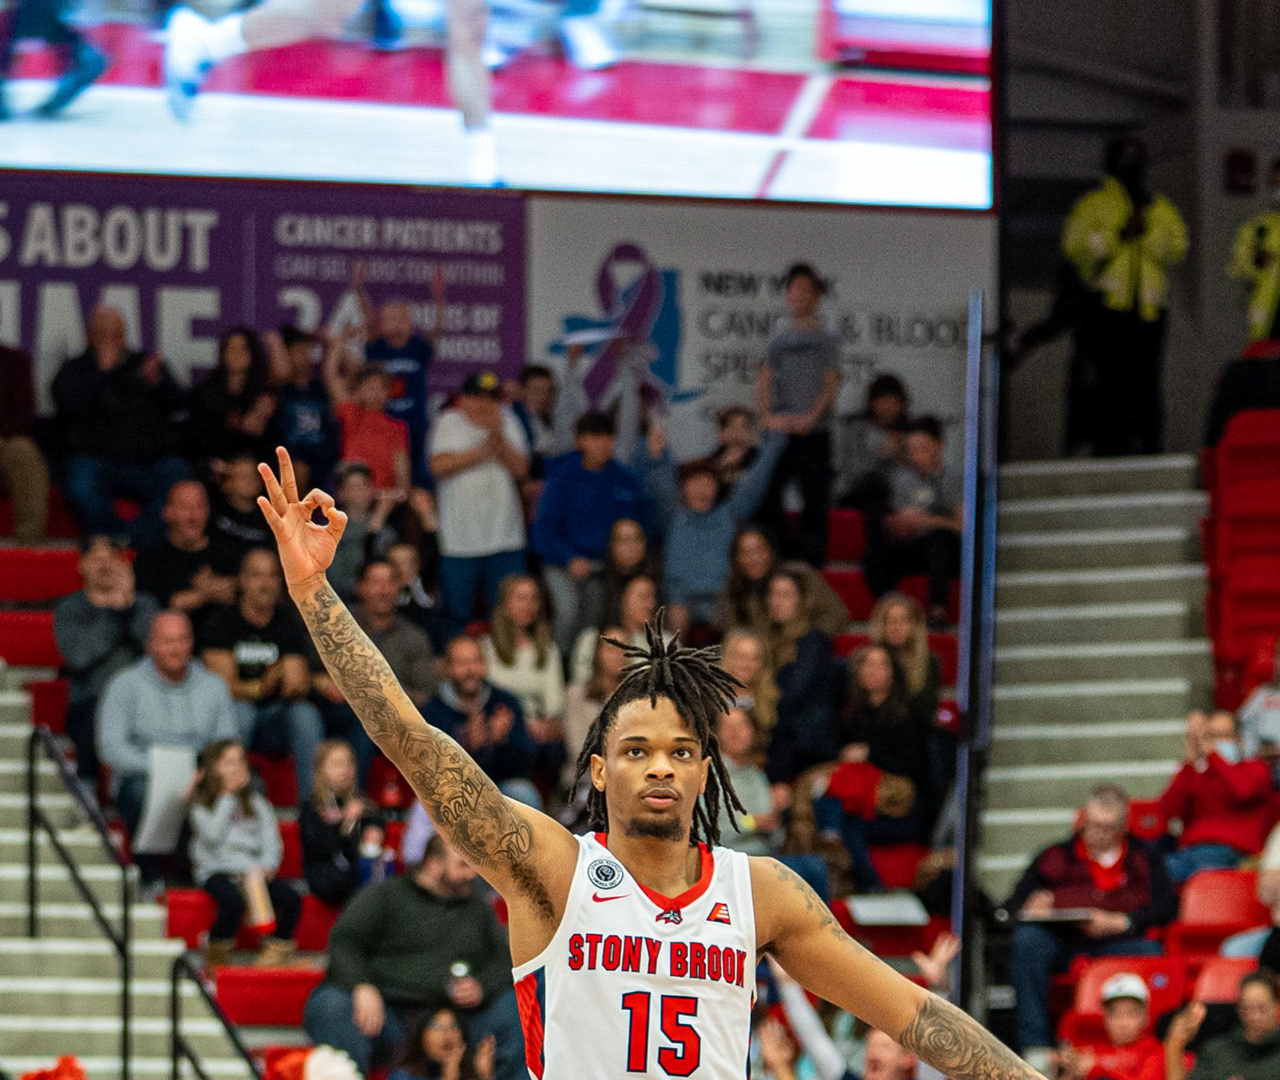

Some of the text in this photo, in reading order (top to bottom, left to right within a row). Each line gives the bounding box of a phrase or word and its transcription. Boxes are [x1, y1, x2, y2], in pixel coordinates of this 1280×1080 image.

[21, 202, 219, 273] ABOUT
[275, 214, 504, 255] CANCER PATIENTS
[568, 932, 747, 988] STONY BROOK
[621, 990, 701, 1078] 15
